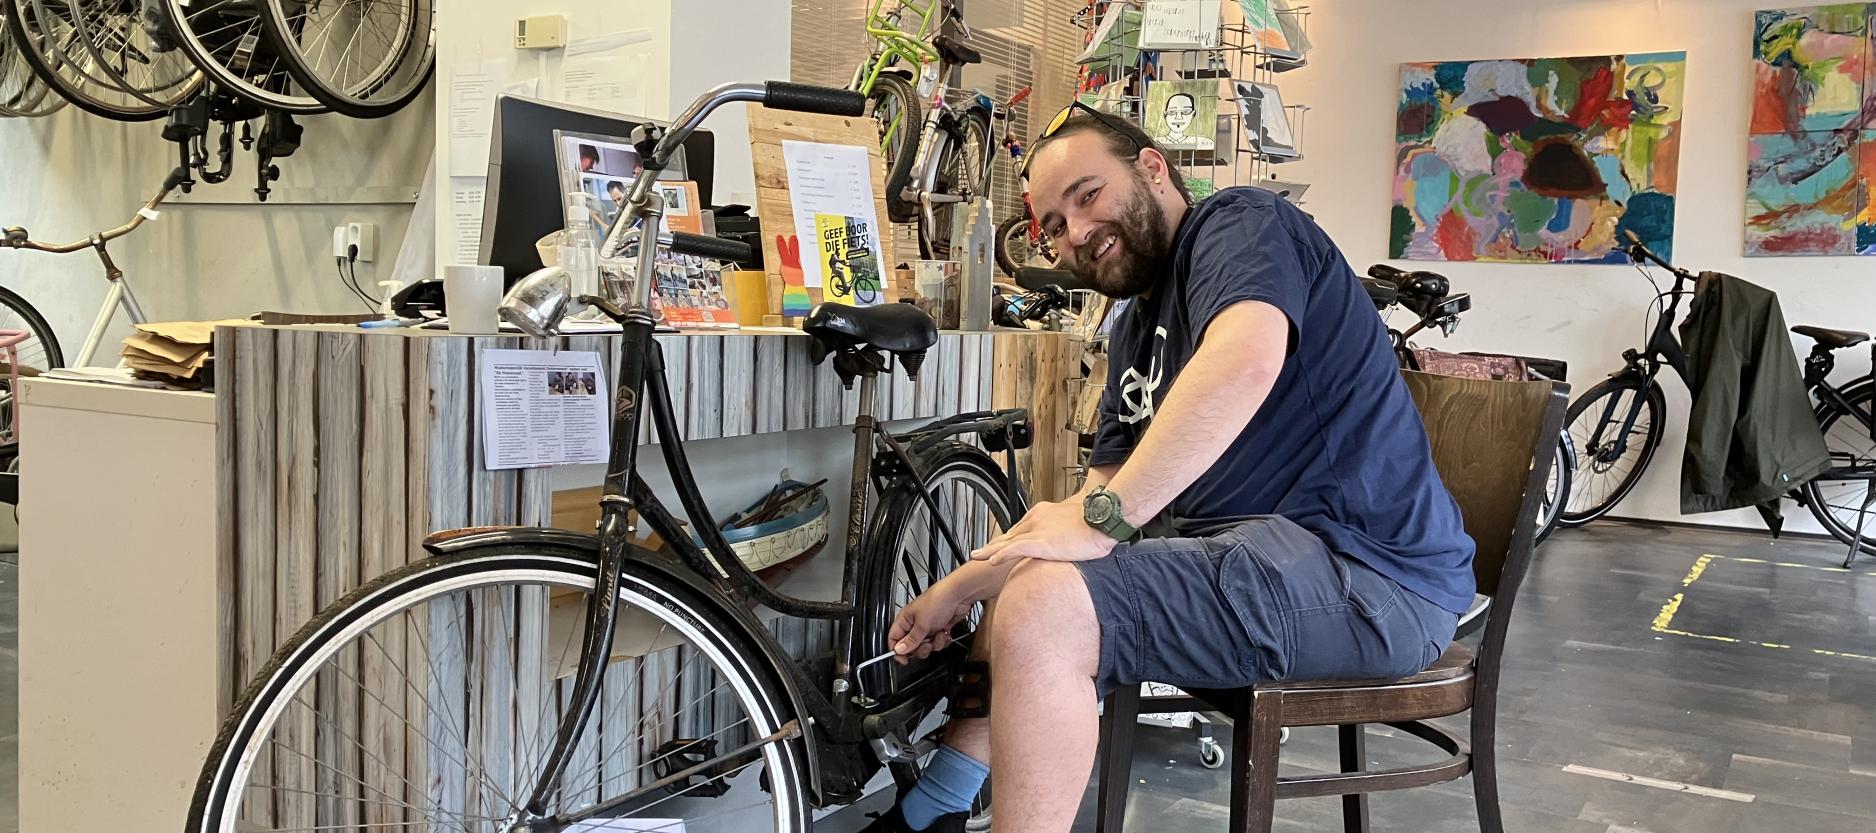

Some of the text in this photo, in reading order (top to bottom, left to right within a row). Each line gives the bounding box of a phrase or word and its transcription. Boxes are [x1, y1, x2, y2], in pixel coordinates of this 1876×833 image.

[824, 223, 867, 240] GEEF DOOR
[825, 234, 869, 252] DIE FIETS!
[663, 601, 674, 612] NO
[674, 608, 706, 633] PUNCTURE
